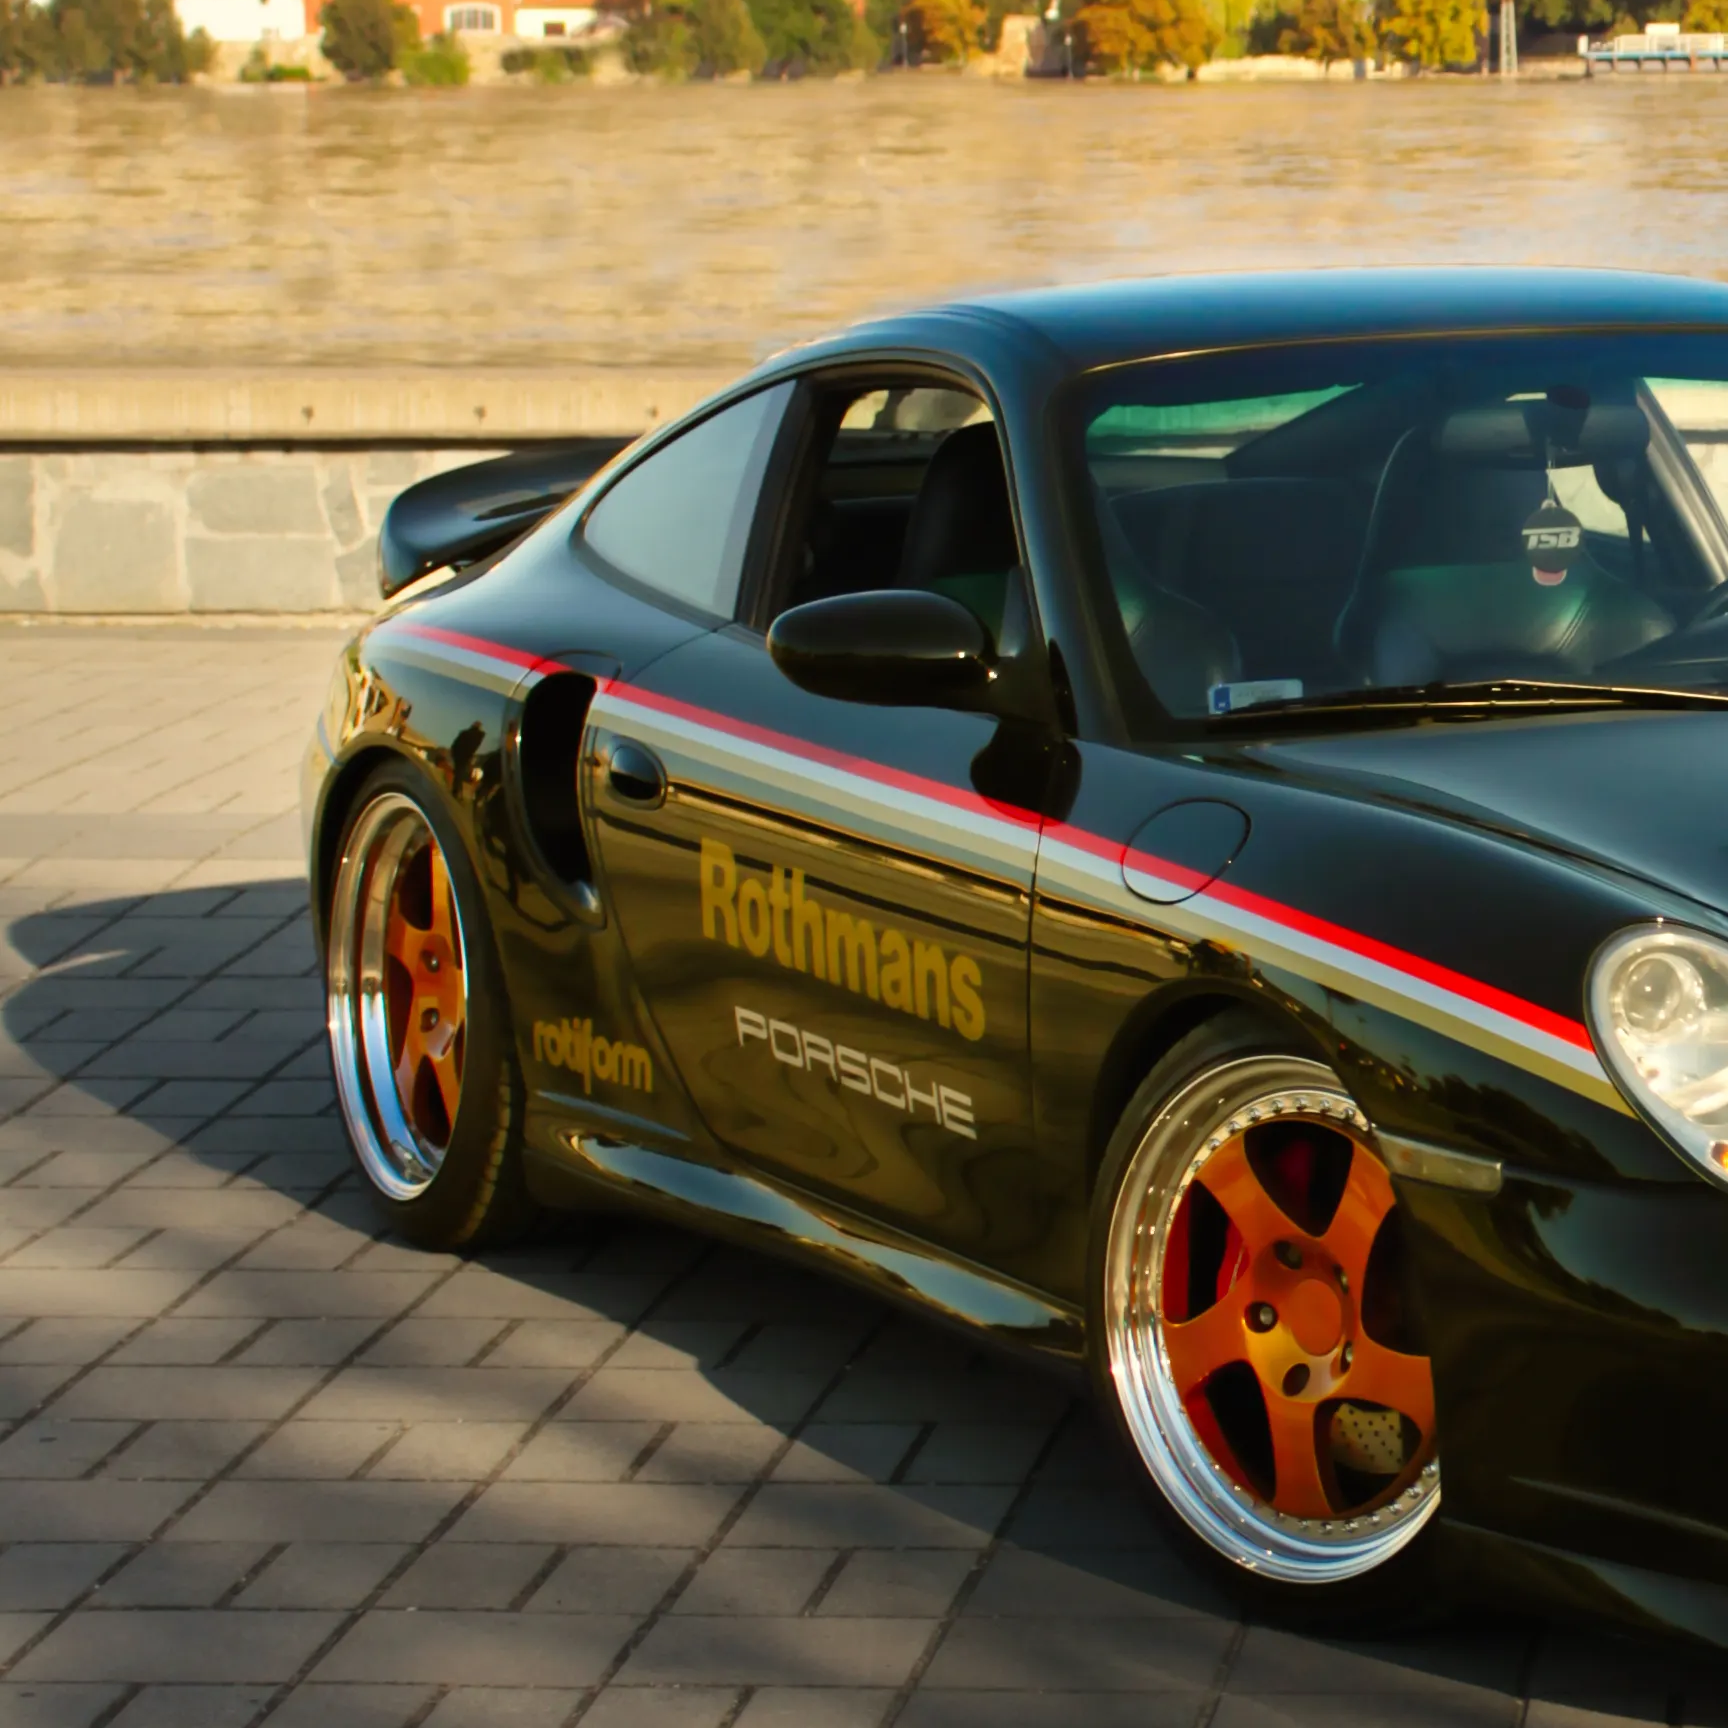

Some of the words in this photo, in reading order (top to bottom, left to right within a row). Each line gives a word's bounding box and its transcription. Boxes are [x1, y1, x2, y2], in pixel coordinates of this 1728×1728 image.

[700, 838, 986, 1041] Rothmans
[533, 1017, 653, 1095] rotiform
[734, 1006, 977, 1140] PORSCHE
